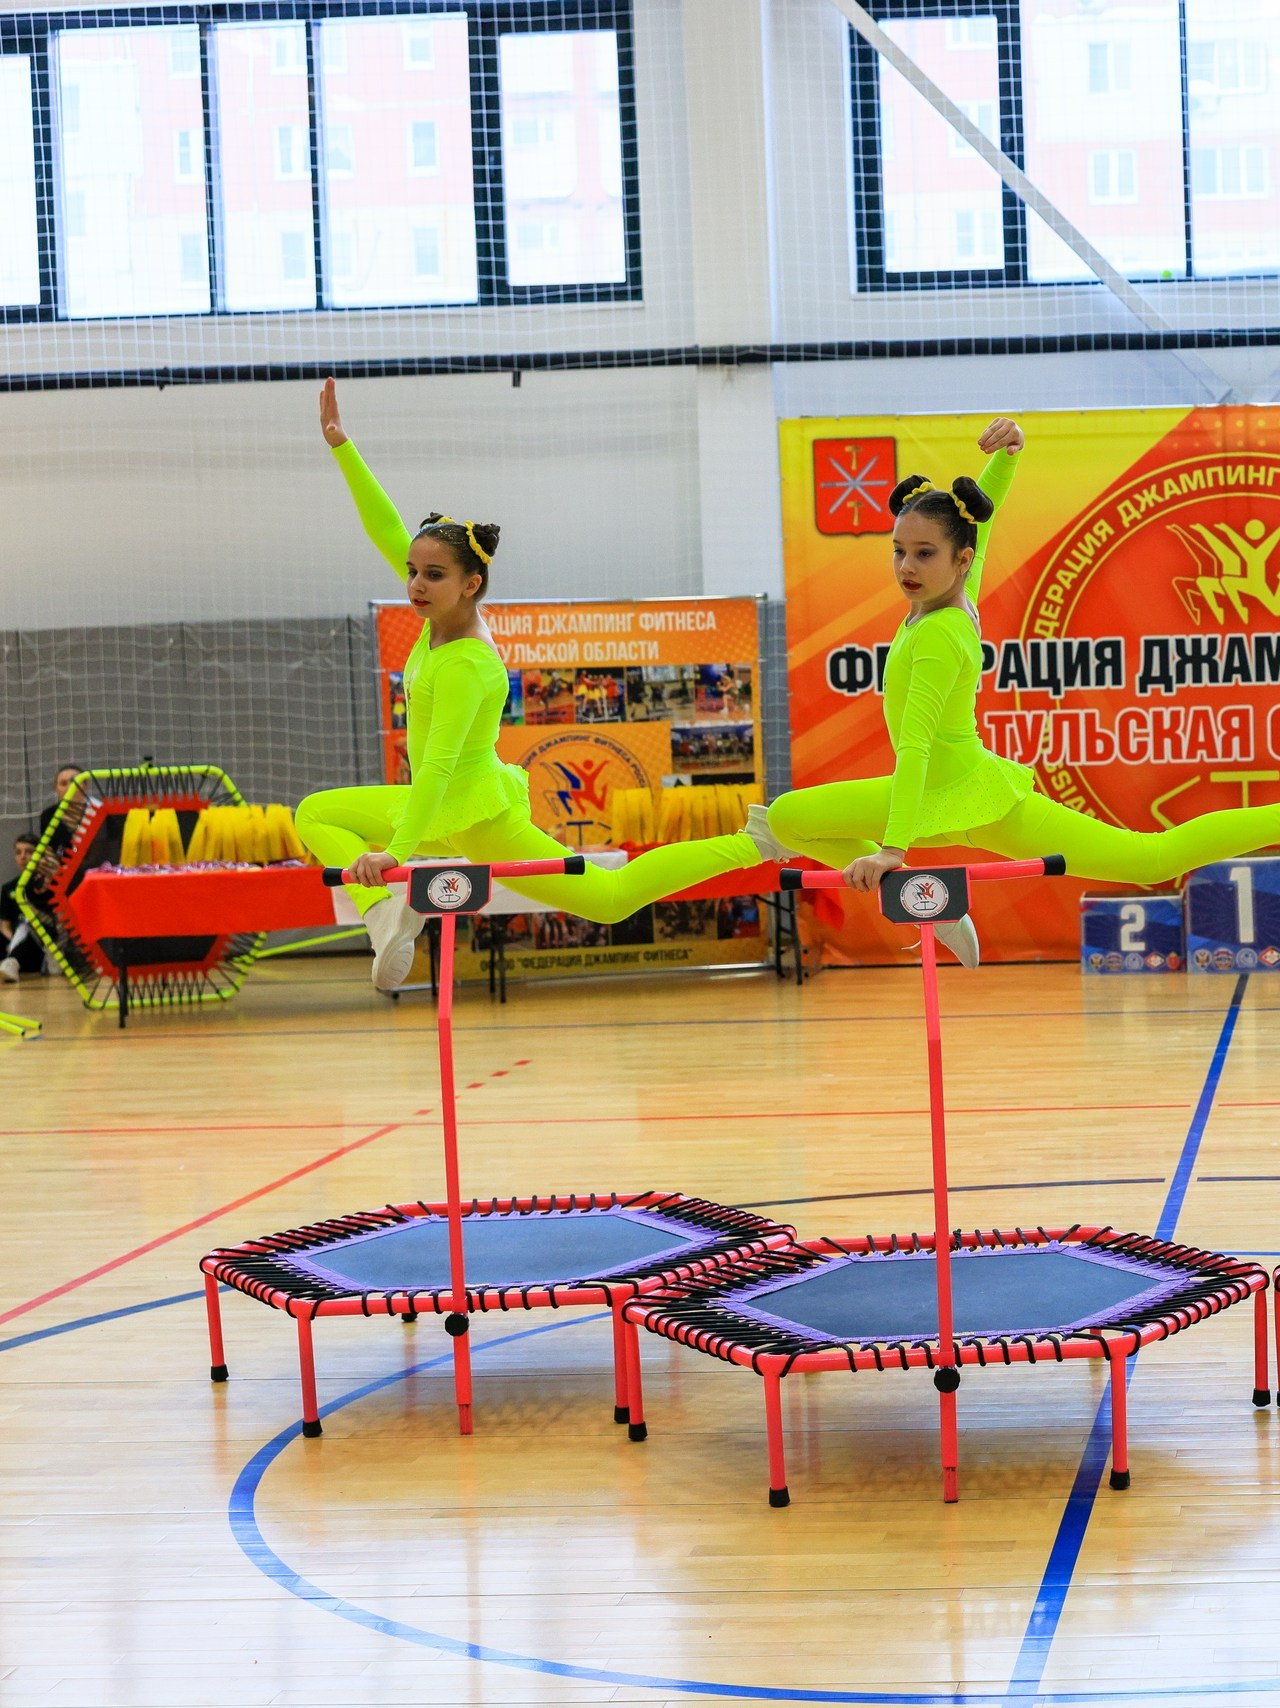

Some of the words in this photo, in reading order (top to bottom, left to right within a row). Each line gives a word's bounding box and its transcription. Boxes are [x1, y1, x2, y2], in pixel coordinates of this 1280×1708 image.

[1033, 519, 1115, 639] ДЕРАЦИЯ
[536, 612, 633, 637] ДЖАМПИНГ
[639, 610, 716, 633] ФИТНЕСА
[583, 640, 659, 662] ОБЛАСТИ
[827, 634, 1126, 698] ФАЦИЯ
[985, 702, 1255, 767] ТУЛЬСКАЯ
[1120, 904, 1146, 951] 2
[1229, 866, 1256, 943] 1
